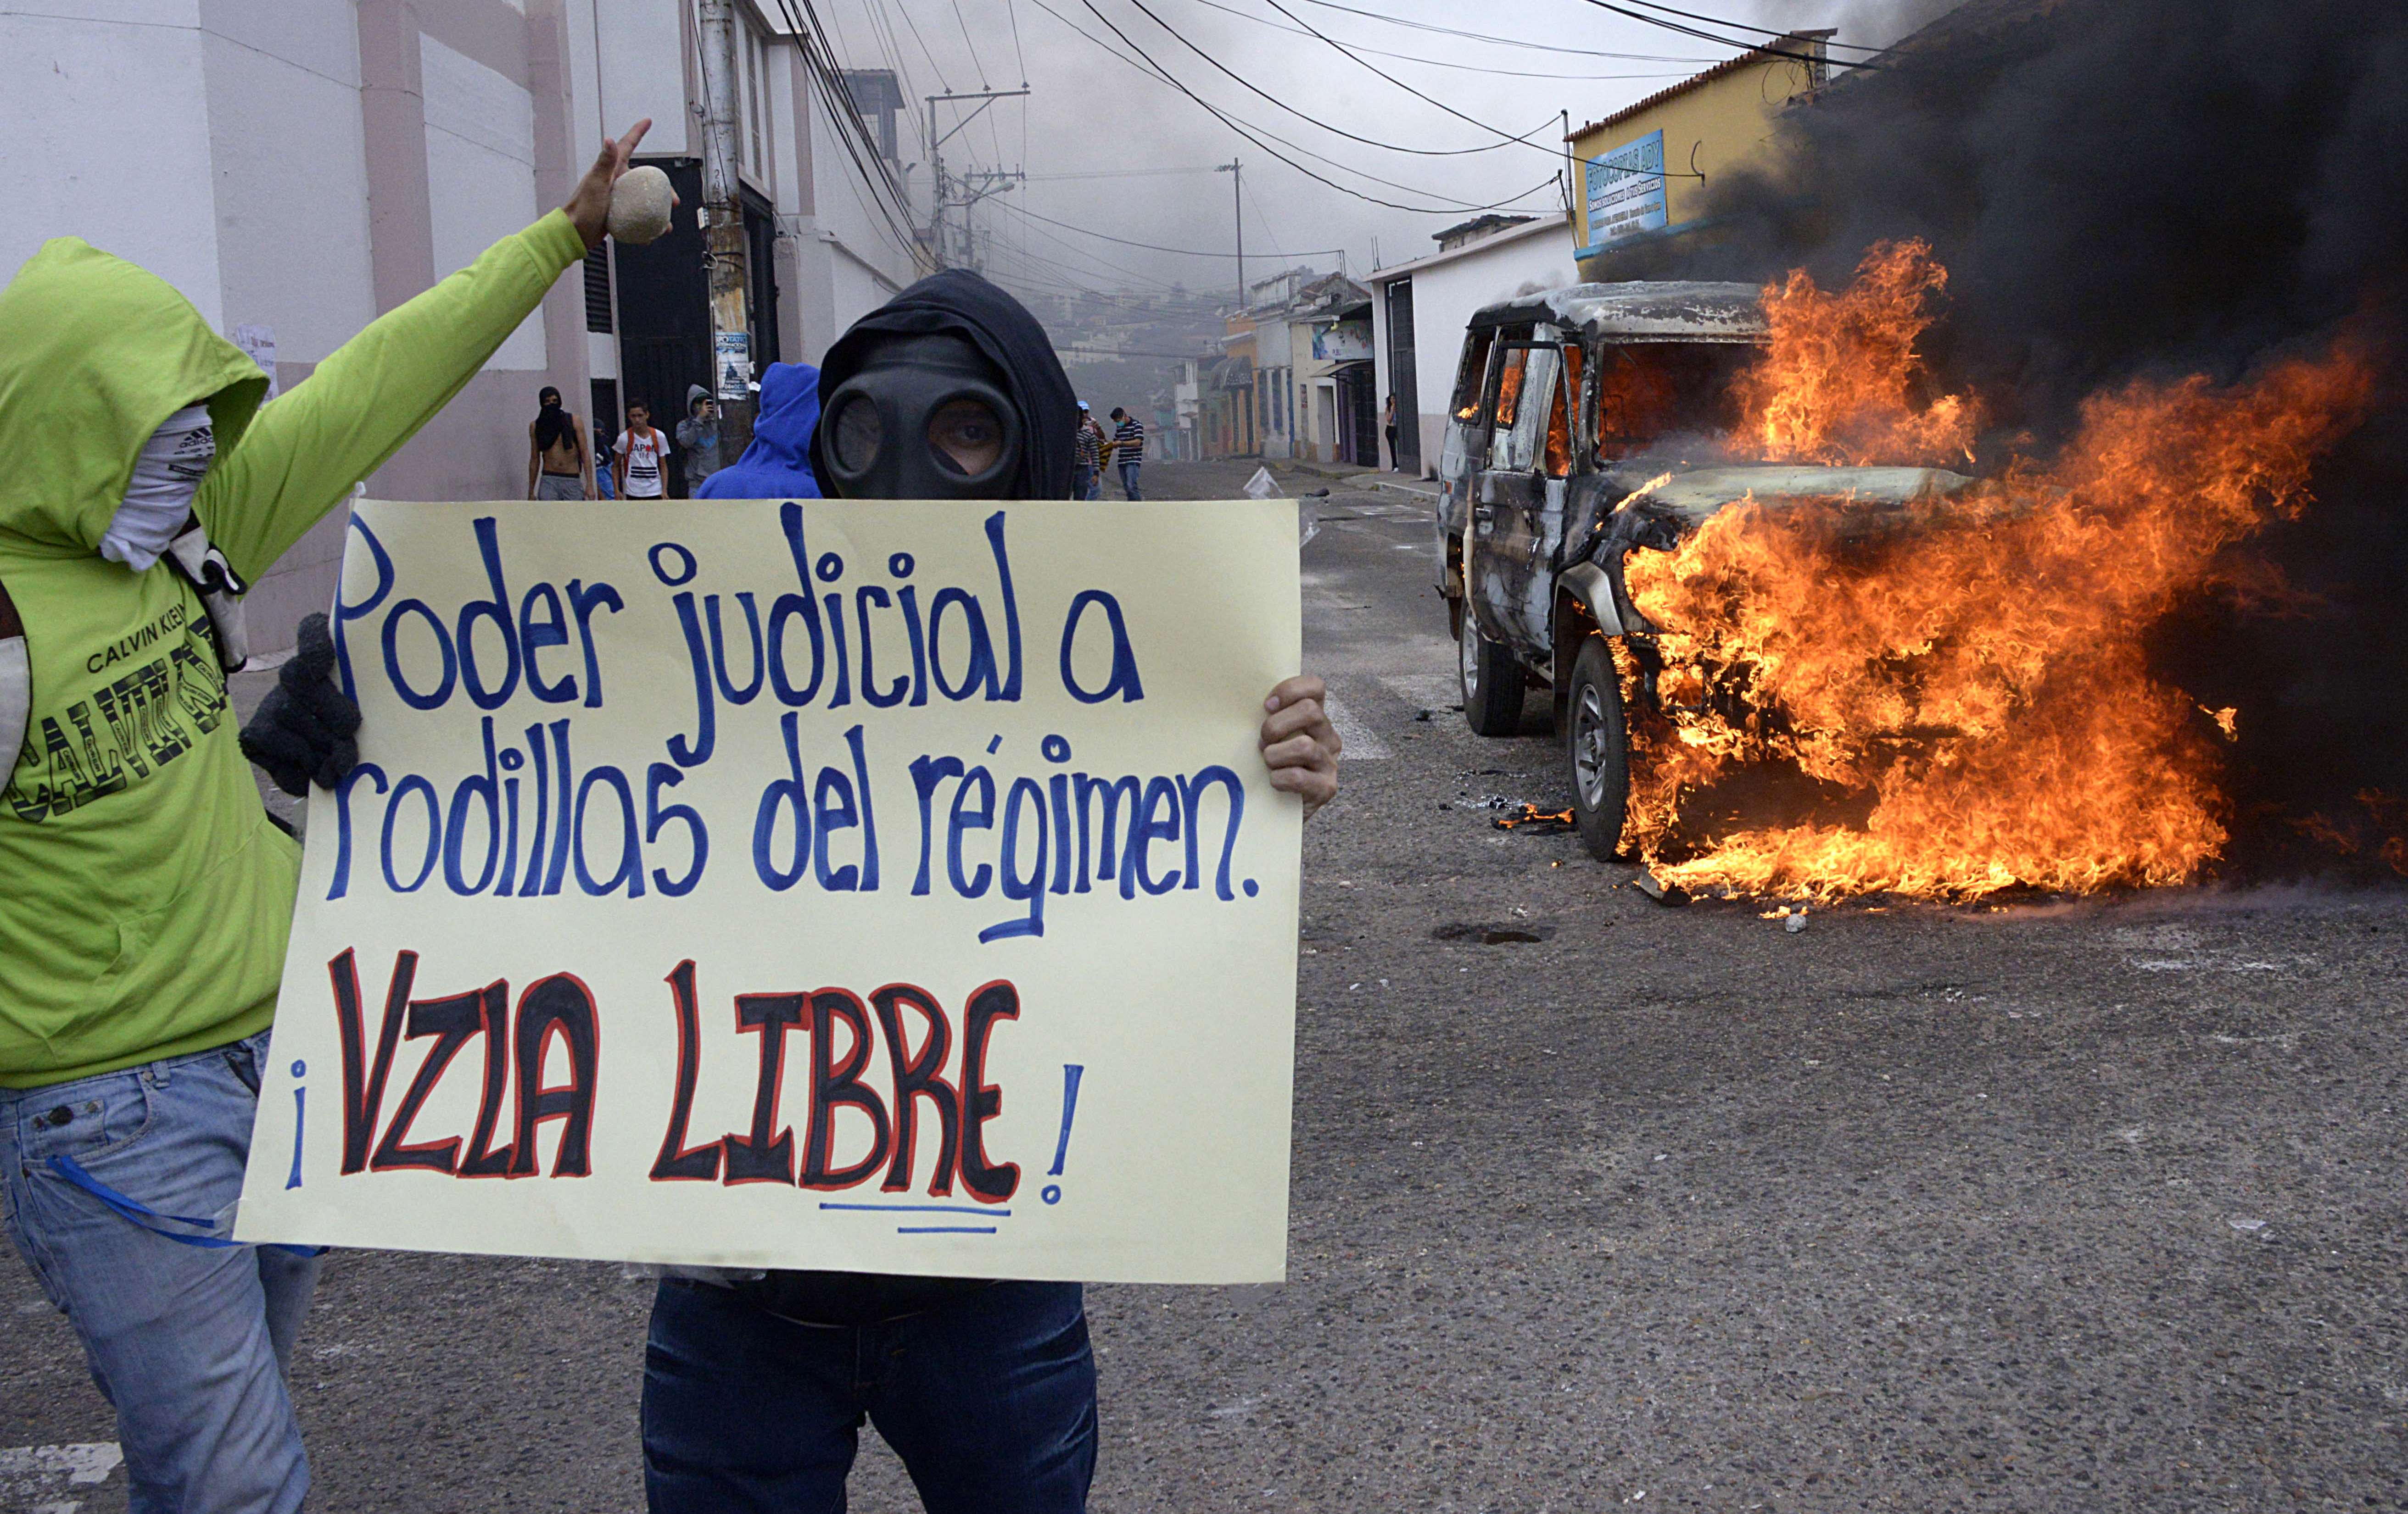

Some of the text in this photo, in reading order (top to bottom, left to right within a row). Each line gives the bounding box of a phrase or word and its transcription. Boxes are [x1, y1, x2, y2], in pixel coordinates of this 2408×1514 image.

[1588, 139, 1660, 192] FOTOCOPIAS ADY
[1637, 176, 1661, 196] SERVICIOS
[179, 436, 213, 448] adid
[87, 622, 158, 673] CALVIN
[333, 502, 1144, 768] Poder judicial a
[752, 711, 879, 892] del
[908, 734, 1259, 944] régimen.
